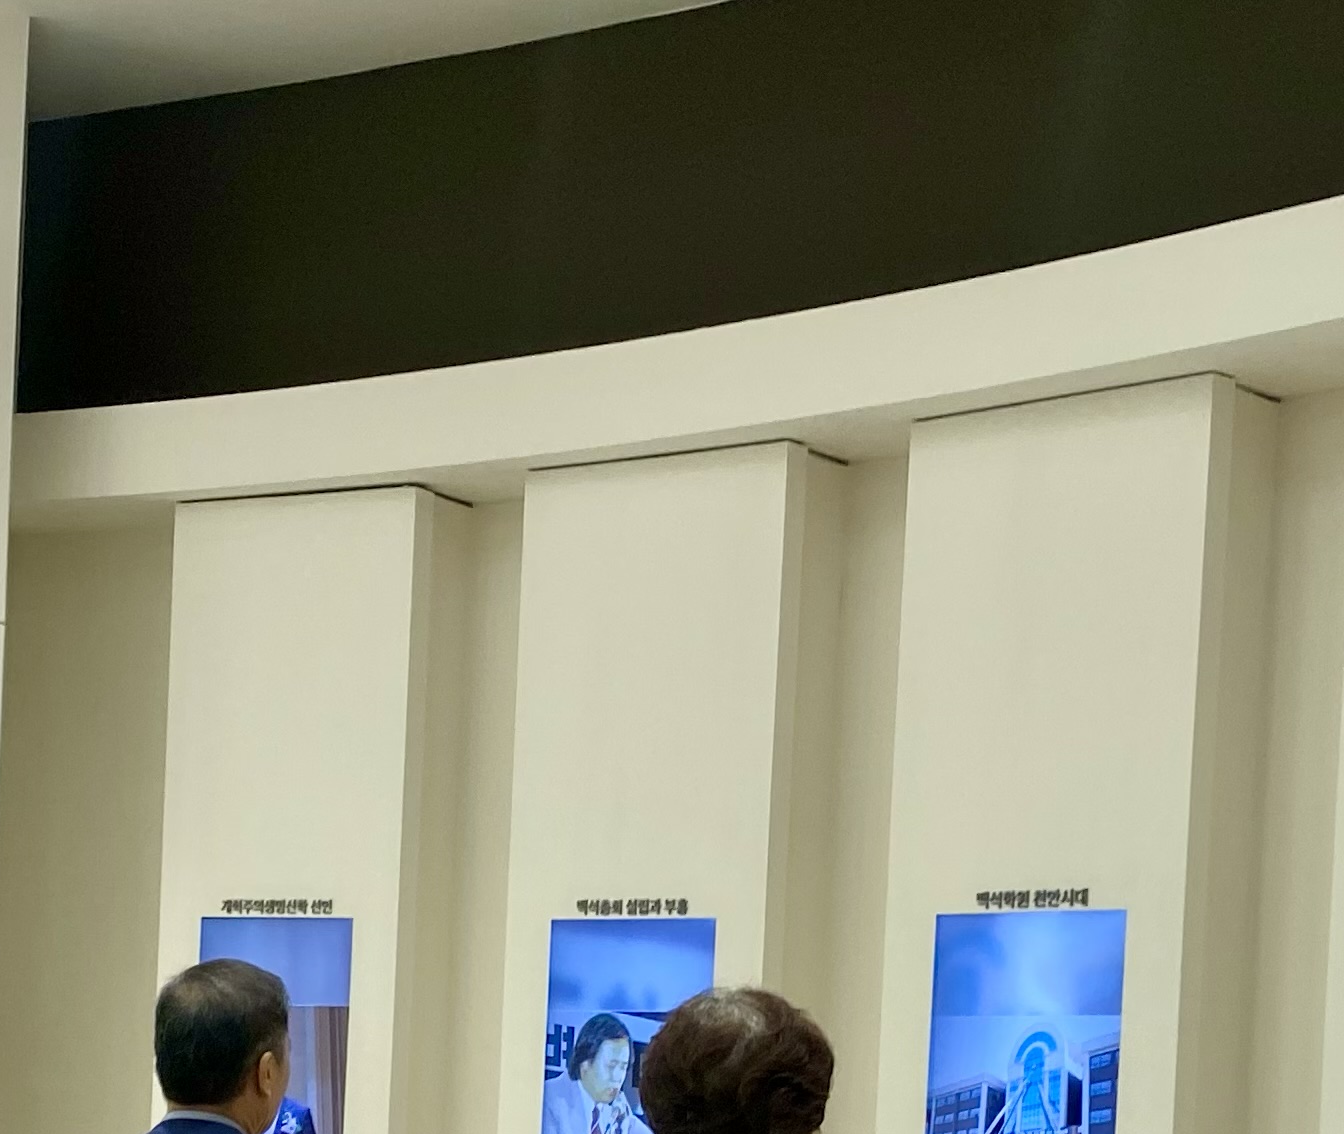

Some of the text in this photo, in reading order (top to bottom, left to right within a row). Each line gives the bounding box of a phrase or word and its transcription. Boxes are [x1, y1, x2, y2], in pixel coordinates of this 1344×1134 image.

[626, 898, 661, 916] 설립과
[976, 887, 1089, 910] 백석학원 천안시대
